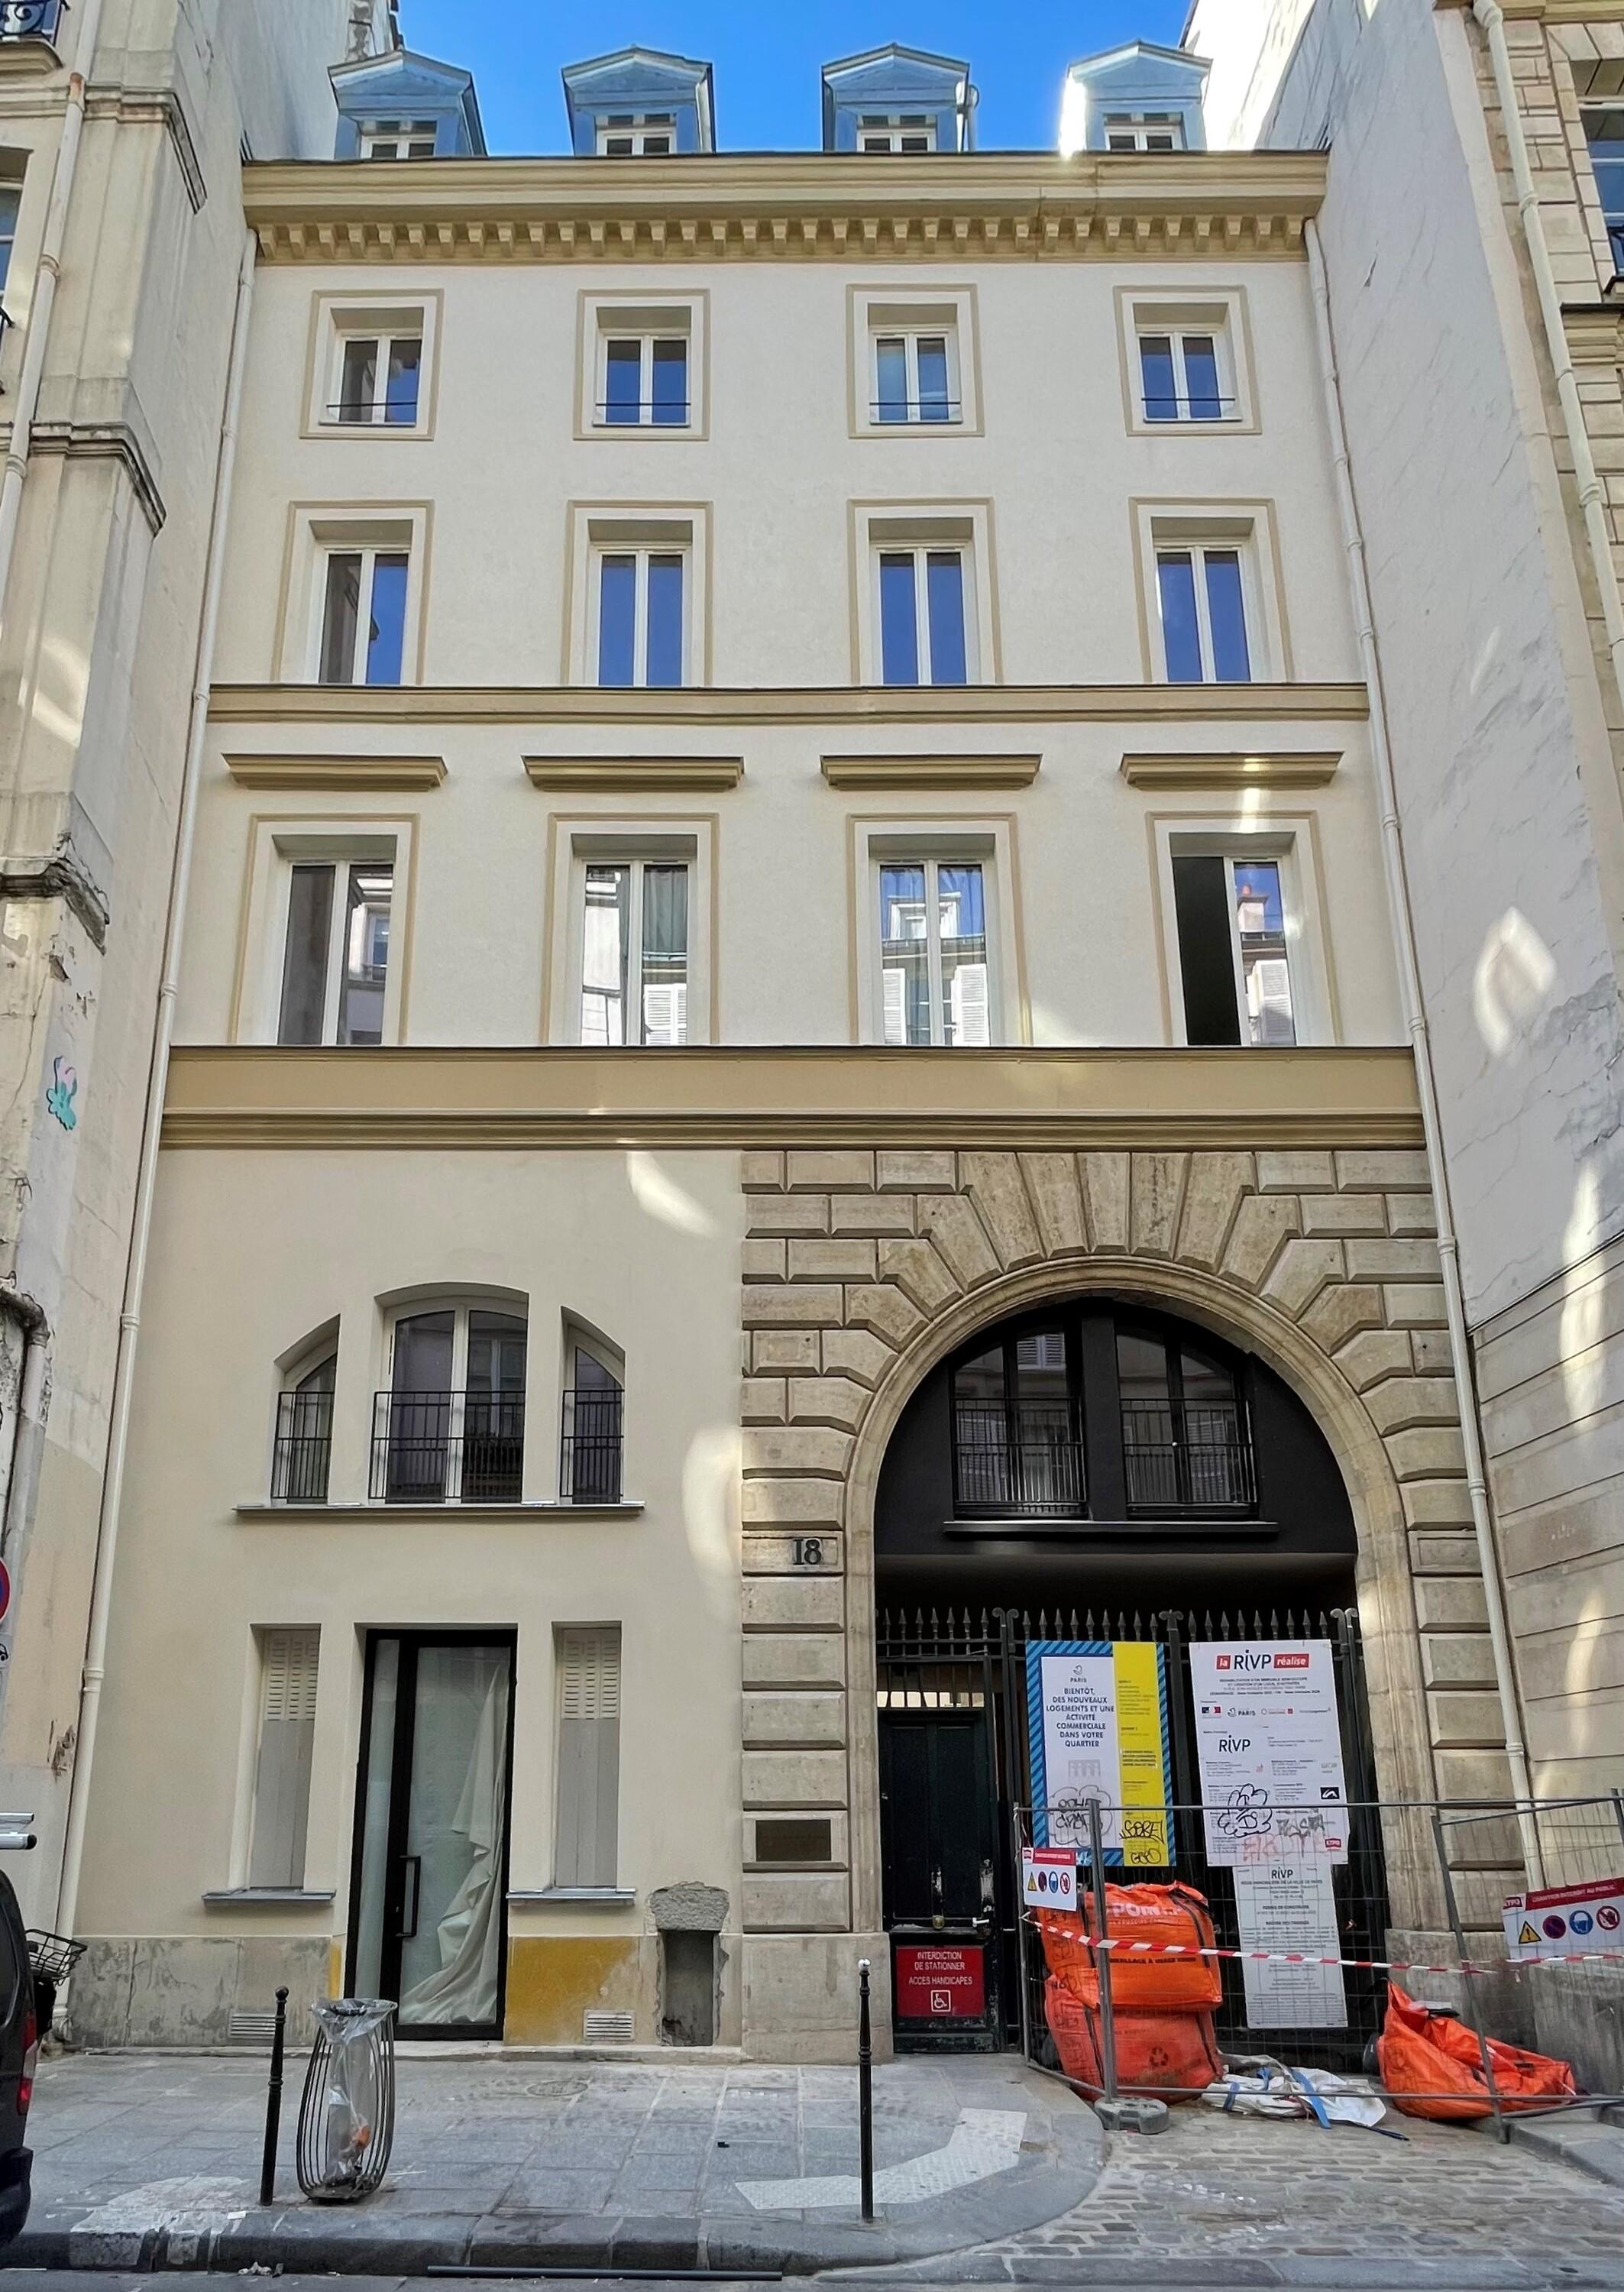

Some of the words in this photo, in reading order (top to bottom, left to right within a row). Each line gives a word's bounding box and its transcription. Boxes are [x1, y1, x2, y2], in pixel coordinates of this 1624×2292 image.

[793, 1538, 822, 1565] 18
[1219, 1656, 1228, 1667] la
[1276, 1654, 1306, 1666] réalise
[917, 1951, 962, 1960] INTERDICTION
[914, 1961, 924, 1970] DE
[924, 1961, 966, 1970] STATIONNER
[909, 1976, 931, 1985] ACCES
[931, 1976, 972, 1985] HANDICAPES
